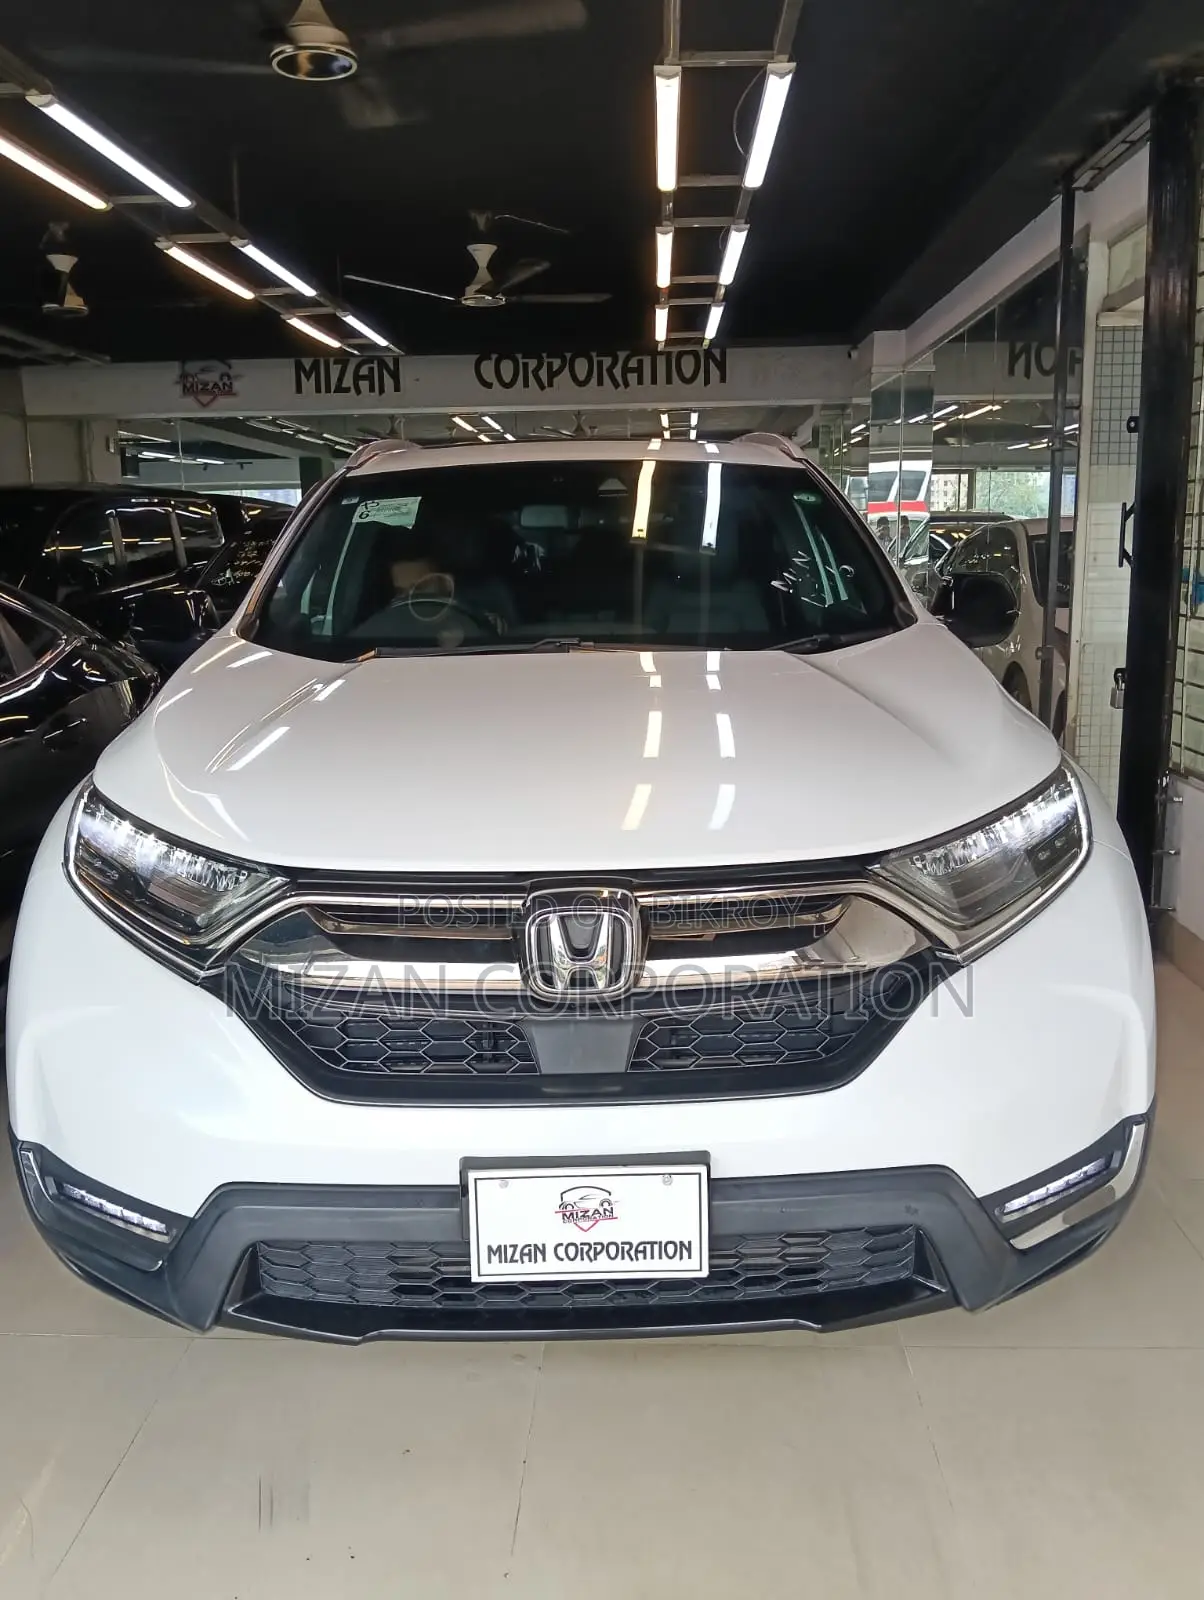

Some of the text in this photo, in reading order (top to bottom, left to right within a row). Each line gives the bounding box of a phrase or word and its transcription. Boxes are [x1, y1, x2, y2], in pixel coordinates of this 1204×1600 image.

[295, 346, 727, 396] MIZAN CORPORATION
[182, 380, 233, 397] MIZAN
[562, 1206, 614, 1222] MIZAN
[487, 1240, 692, 1265] MIZAN CORPORATION
